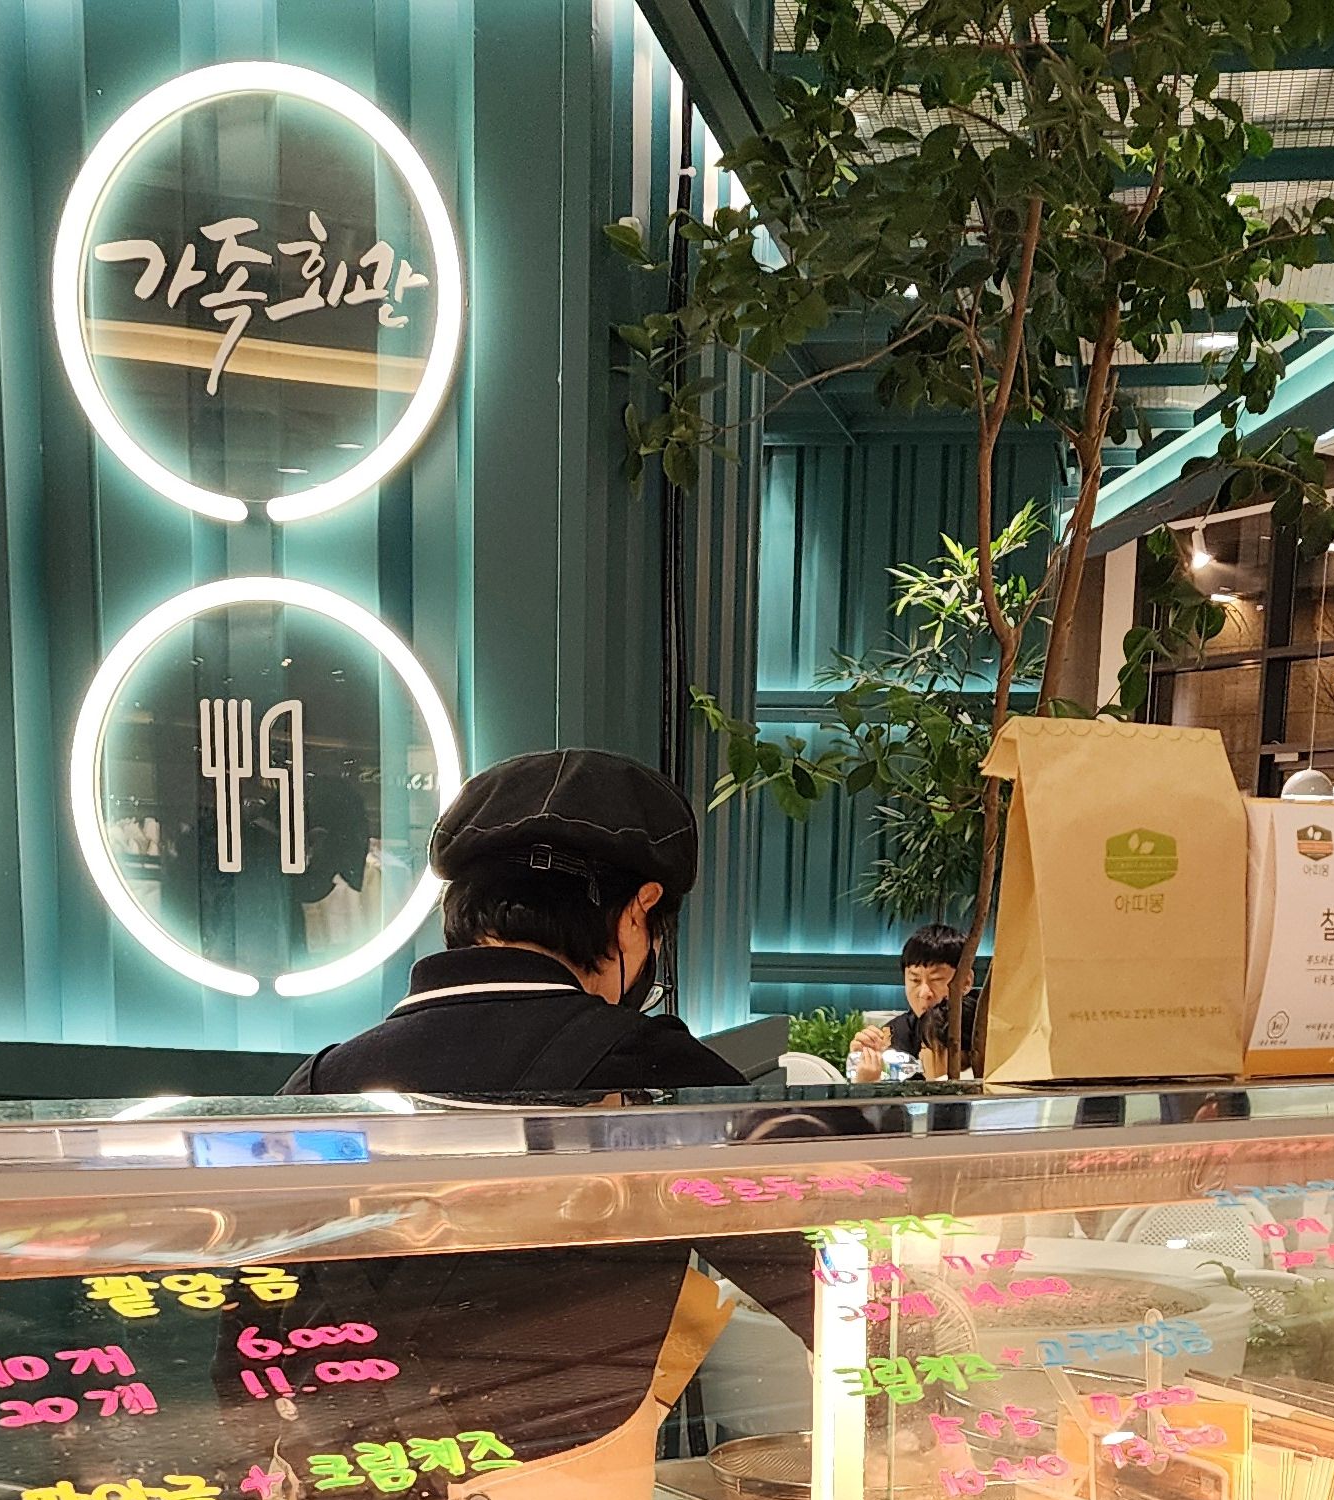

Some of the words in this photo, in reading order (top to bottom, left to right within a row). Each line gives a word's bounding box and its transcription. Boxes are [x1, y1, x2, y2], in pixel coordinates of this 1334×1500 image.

[94, 209, 428, 396] 가족회관
[832, 1353, 1004, 1404] 크림치즈
[308, 1430, 524, 1493] 크림치즈
